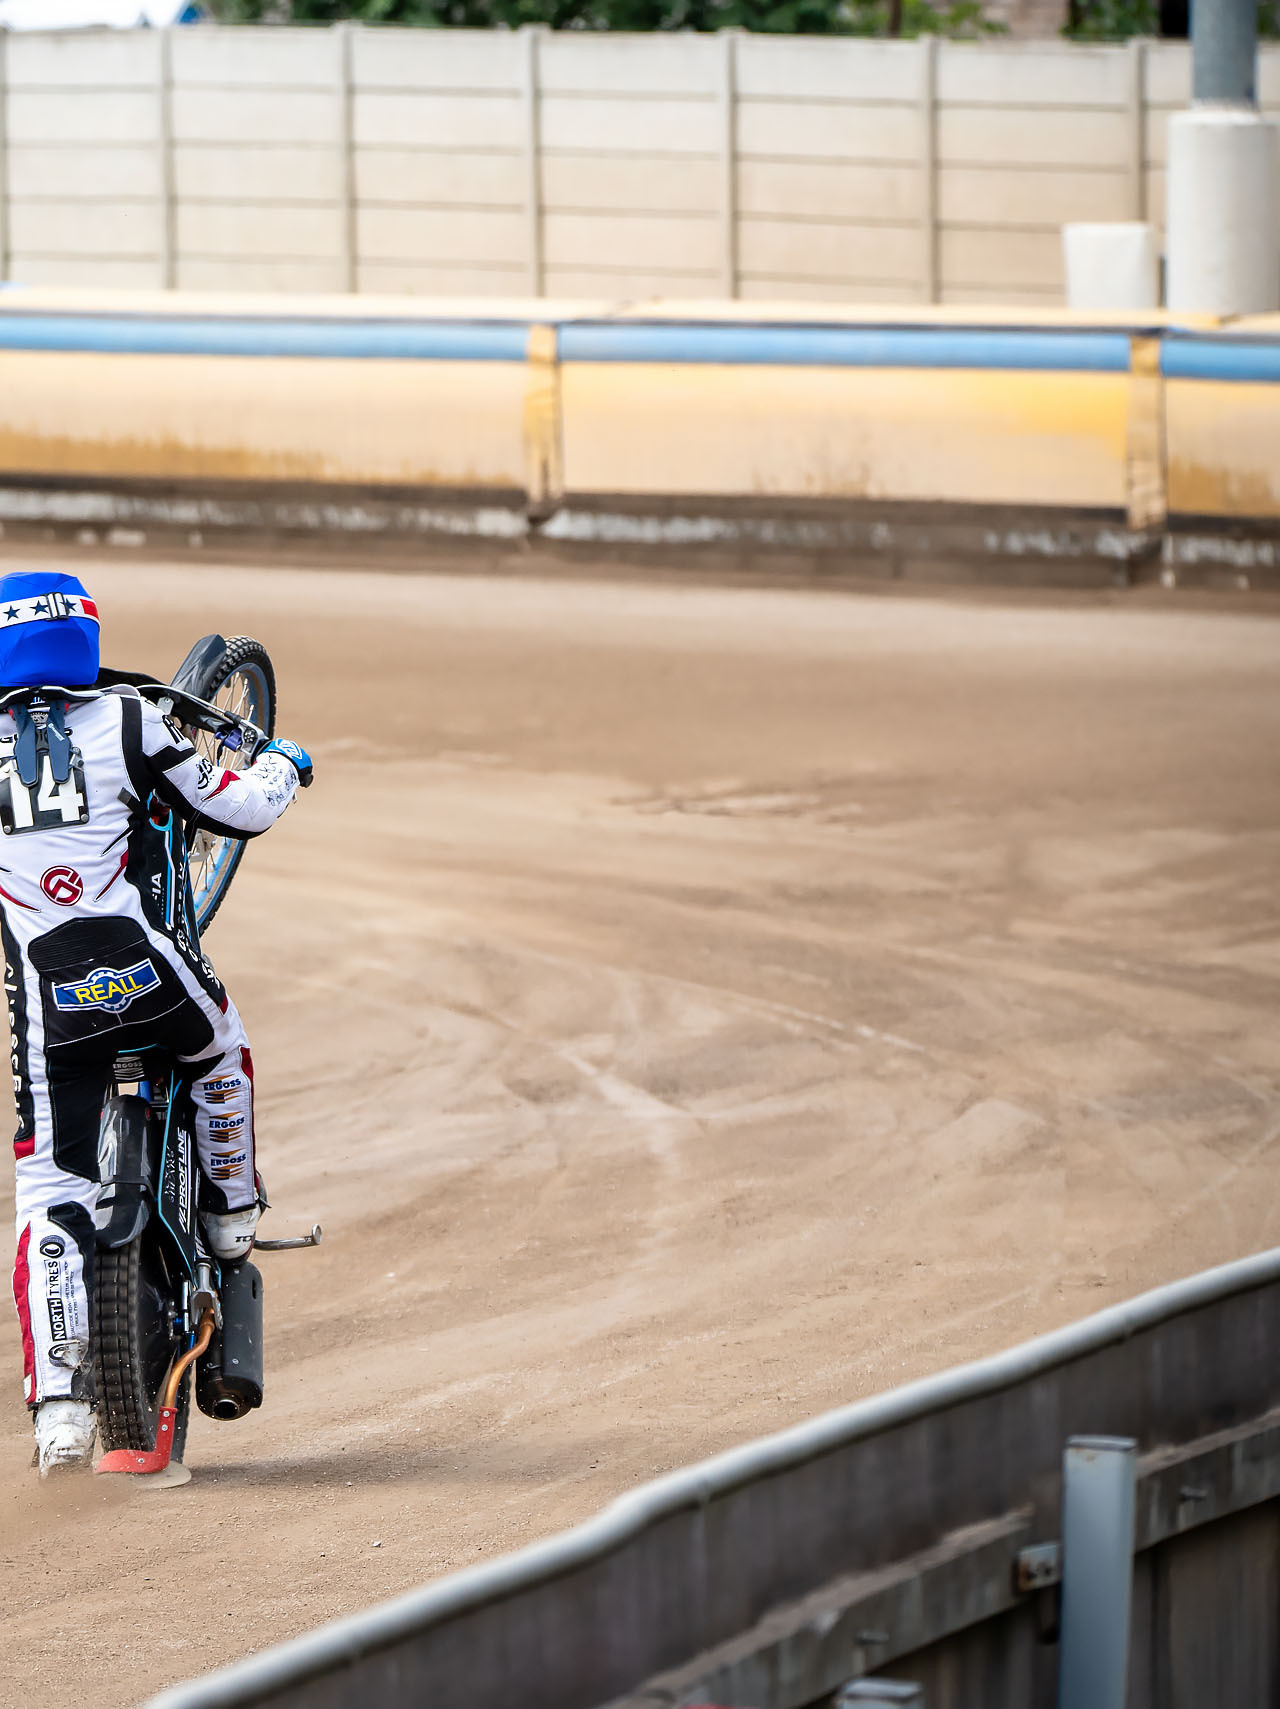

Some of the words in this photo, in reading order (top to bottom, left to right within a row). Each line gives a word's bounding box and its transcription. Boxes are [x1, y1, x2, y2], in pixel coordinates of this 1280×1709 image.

[74, 975, 144, 1004] REALL
[112, 1061, 143, 1069] ERGOSS
[203, 1078, 242, 1091] ERGOSS
[208, 1116, 245, 1129] ERGOSS
[210, 1153, 247, 1167] ERGOSS
[177, 1127, 188, 1208] PROFLINE
[234, 1235, 253, 1243] TC
[47, 1260, 60, 1296] TYRES
[50, 1298, 67, 1340] NORTH
